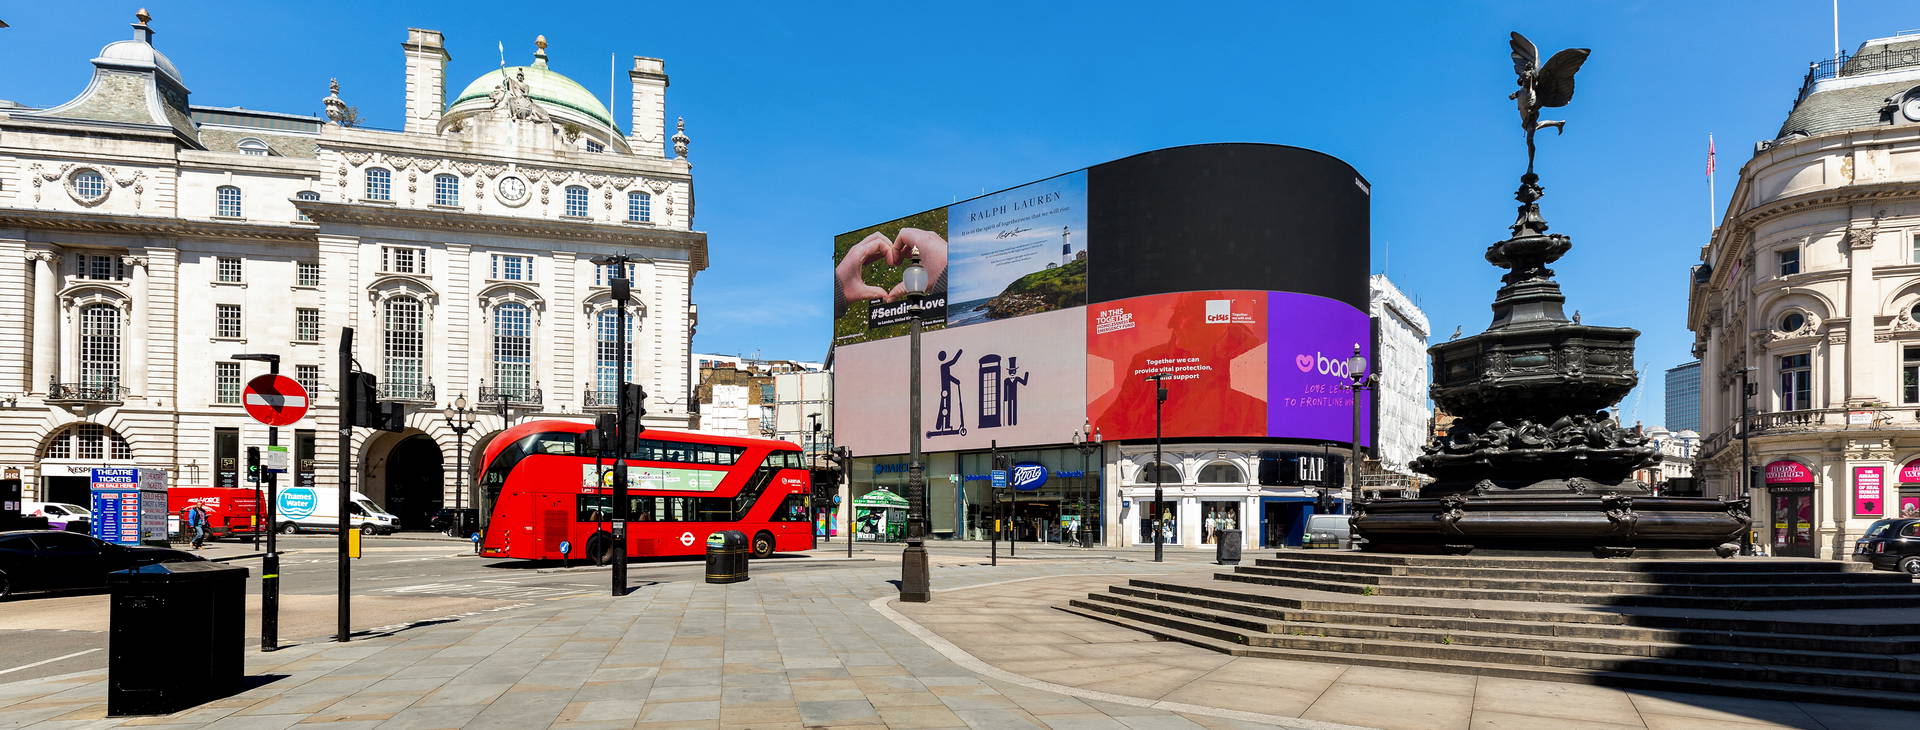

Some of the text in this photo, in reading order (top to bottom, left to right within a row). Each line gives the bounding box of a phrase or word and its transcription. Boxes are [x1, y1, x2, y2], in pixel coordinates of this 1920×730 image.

[970, 192, 1060, 221] RALPH LAUREN
[872, 298, 945, 320] #Sendin Love
[1108, 308, 1123, 316] THIS
[1096, 313, 1132, 323] TOGETHER
[1208, 313, 1229, 321] crisis
[1135, 367, 1158, 375] provide
[1305, 384, 1326, 394] LOVE
[1285, 398, 1297, 407] TO
[1300, 397, 1343, 407] FRONTLINE
[1300, 457, 1324, 481] GAP
[490, 472, 497, 483] 38
[1014, 466, 1041, 485] Boots
